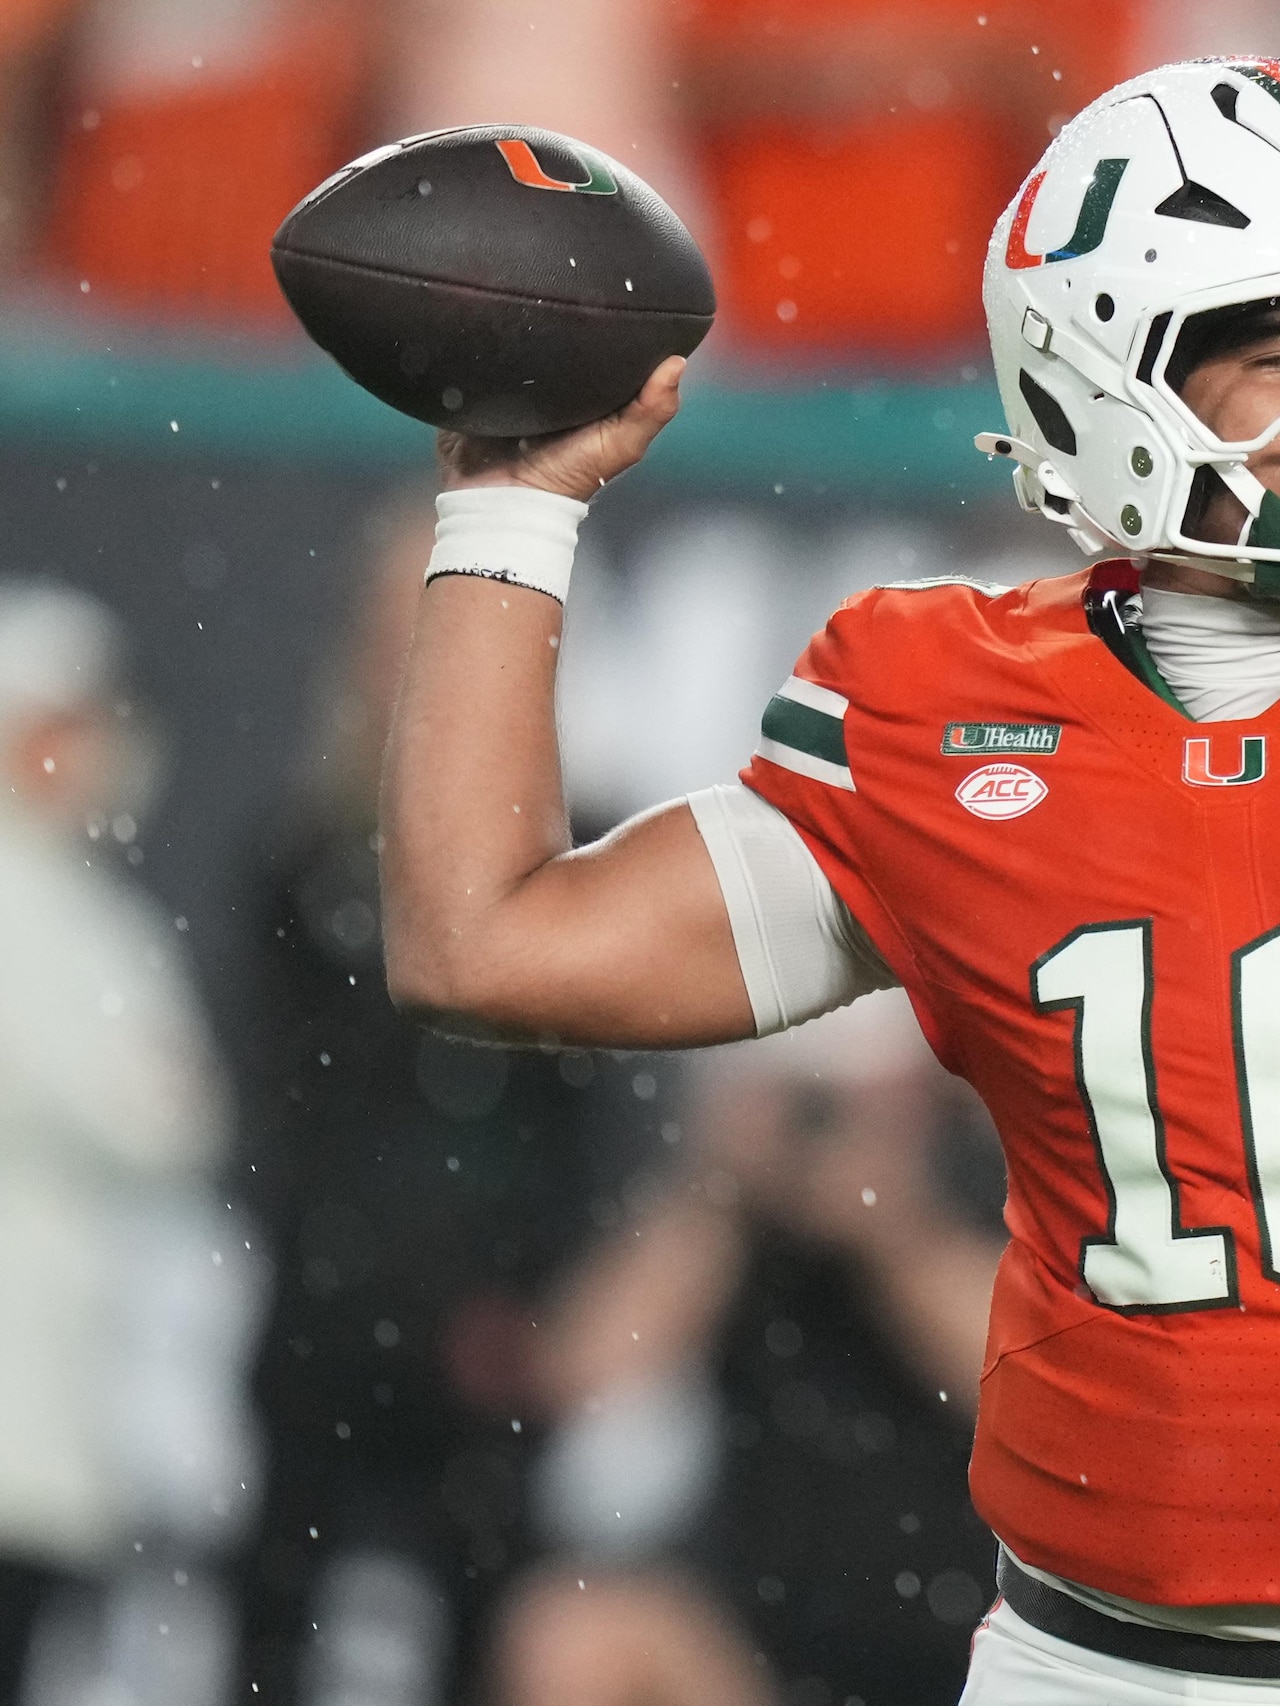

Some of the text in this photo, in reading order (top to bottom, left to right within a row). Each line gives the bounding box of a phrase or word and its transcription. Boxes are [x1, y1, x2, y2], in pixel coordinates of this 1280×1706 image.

[1005, 157, 1131, 271] U
[1182, 735, 1267, 786] U
[970, 778, 1034, 799] ACC
